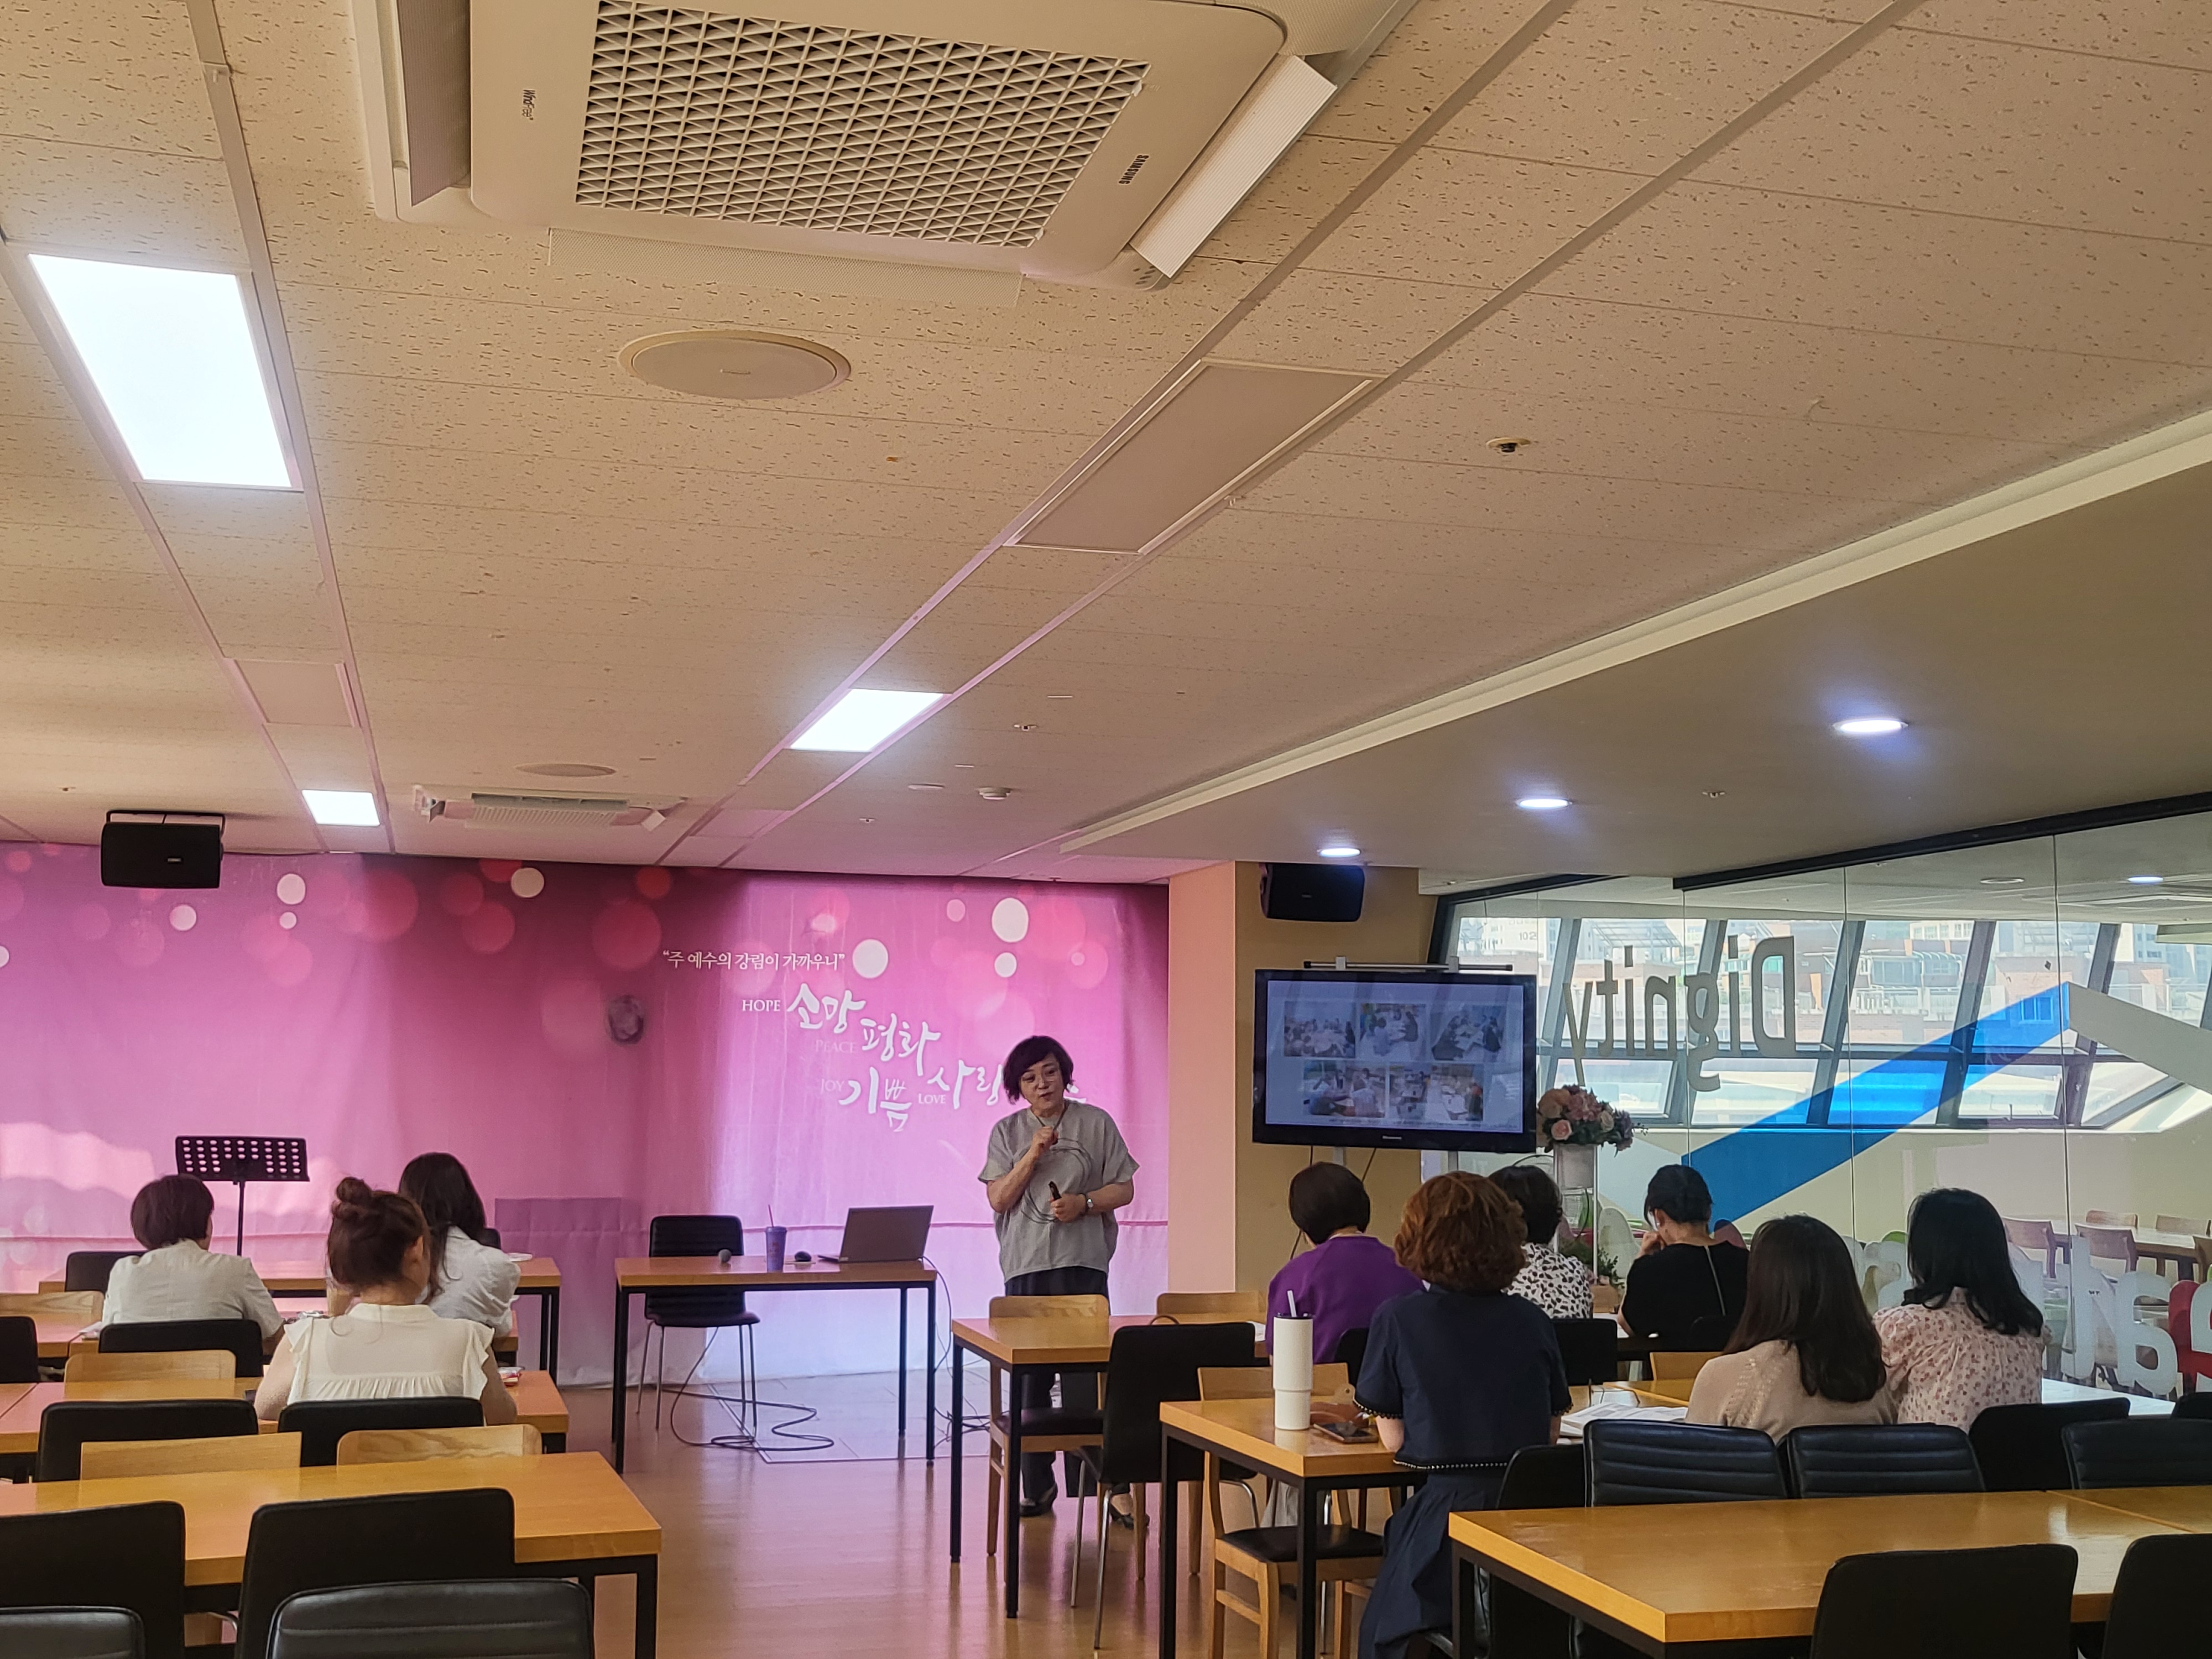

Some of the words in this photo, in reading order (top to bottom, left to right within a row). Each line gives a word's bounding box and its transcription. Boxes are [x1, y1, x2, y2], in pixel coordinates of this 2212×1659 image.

[1118, 155, 1149, 184] SAMSUNG
[1519, 931, 1537, 941] 102
[687, 951, 732, 970] 예수의
[734, 952, 779, 971] 강림이
[782, 953, 845, 971] 가까우니”
[742, 999, 781, 1011] HOPE
[786, 983, 867, 1034] 소망
[859, 1013, 941, 1077] 평화
[838, 1066, 913, 1133] 기쁨
[918, 1093, 947, 1105] LOVE
